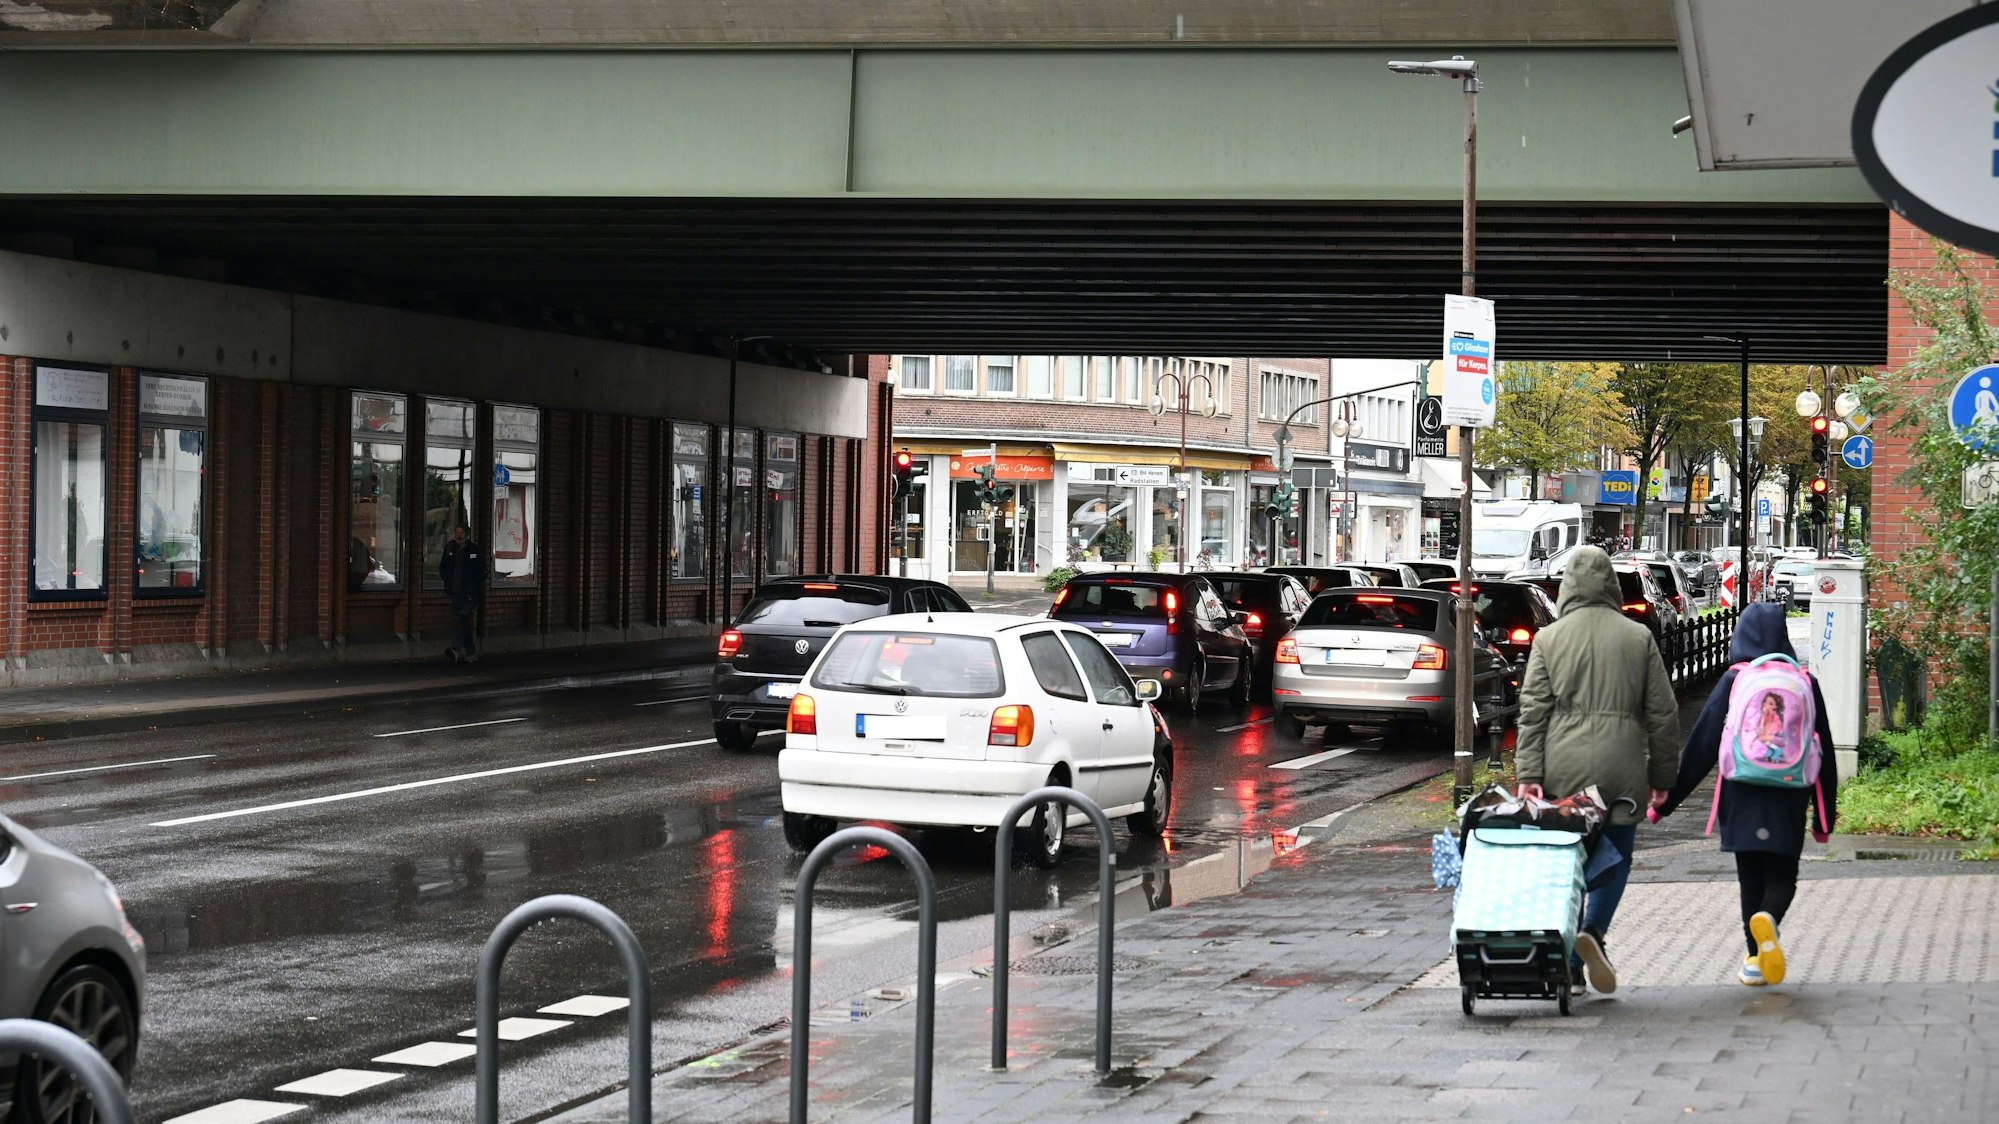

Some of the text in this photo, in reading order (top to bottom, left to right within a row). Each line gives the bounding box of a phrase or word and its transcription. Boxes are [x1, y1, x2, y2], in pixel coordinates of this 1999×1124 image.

[1417, 442, 1444, 455] MELLER
[1604, 481, 1632, 492] TEDi
[1761, 501, 1767, 514] P
